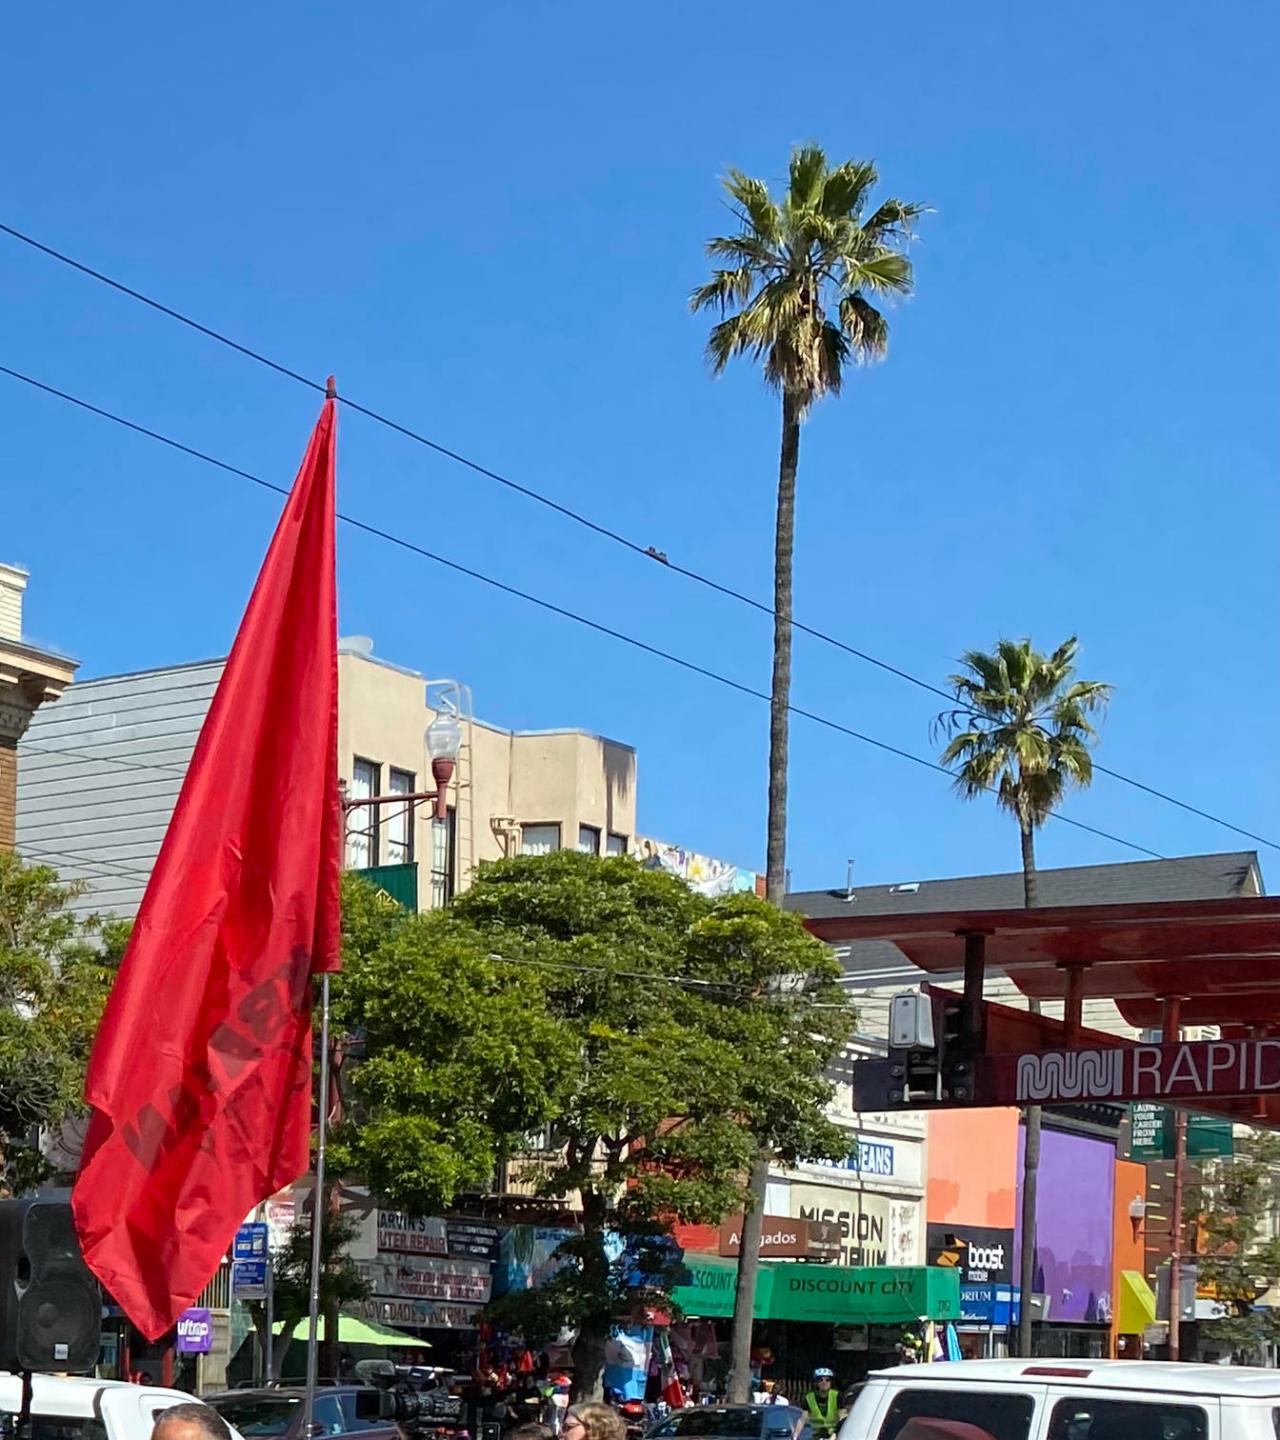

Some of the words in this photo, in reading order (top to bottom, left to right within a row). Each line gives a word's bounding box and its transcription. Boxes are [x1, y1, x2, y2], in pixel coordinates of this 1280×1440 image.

[1132, 1038, 1280, 1095] RAPID
[854, 1143, 891, 1175] JEANS
[968, 1241, 1004, 1270] boost
[790, 1278, 877, 1294] DISCOUNT
